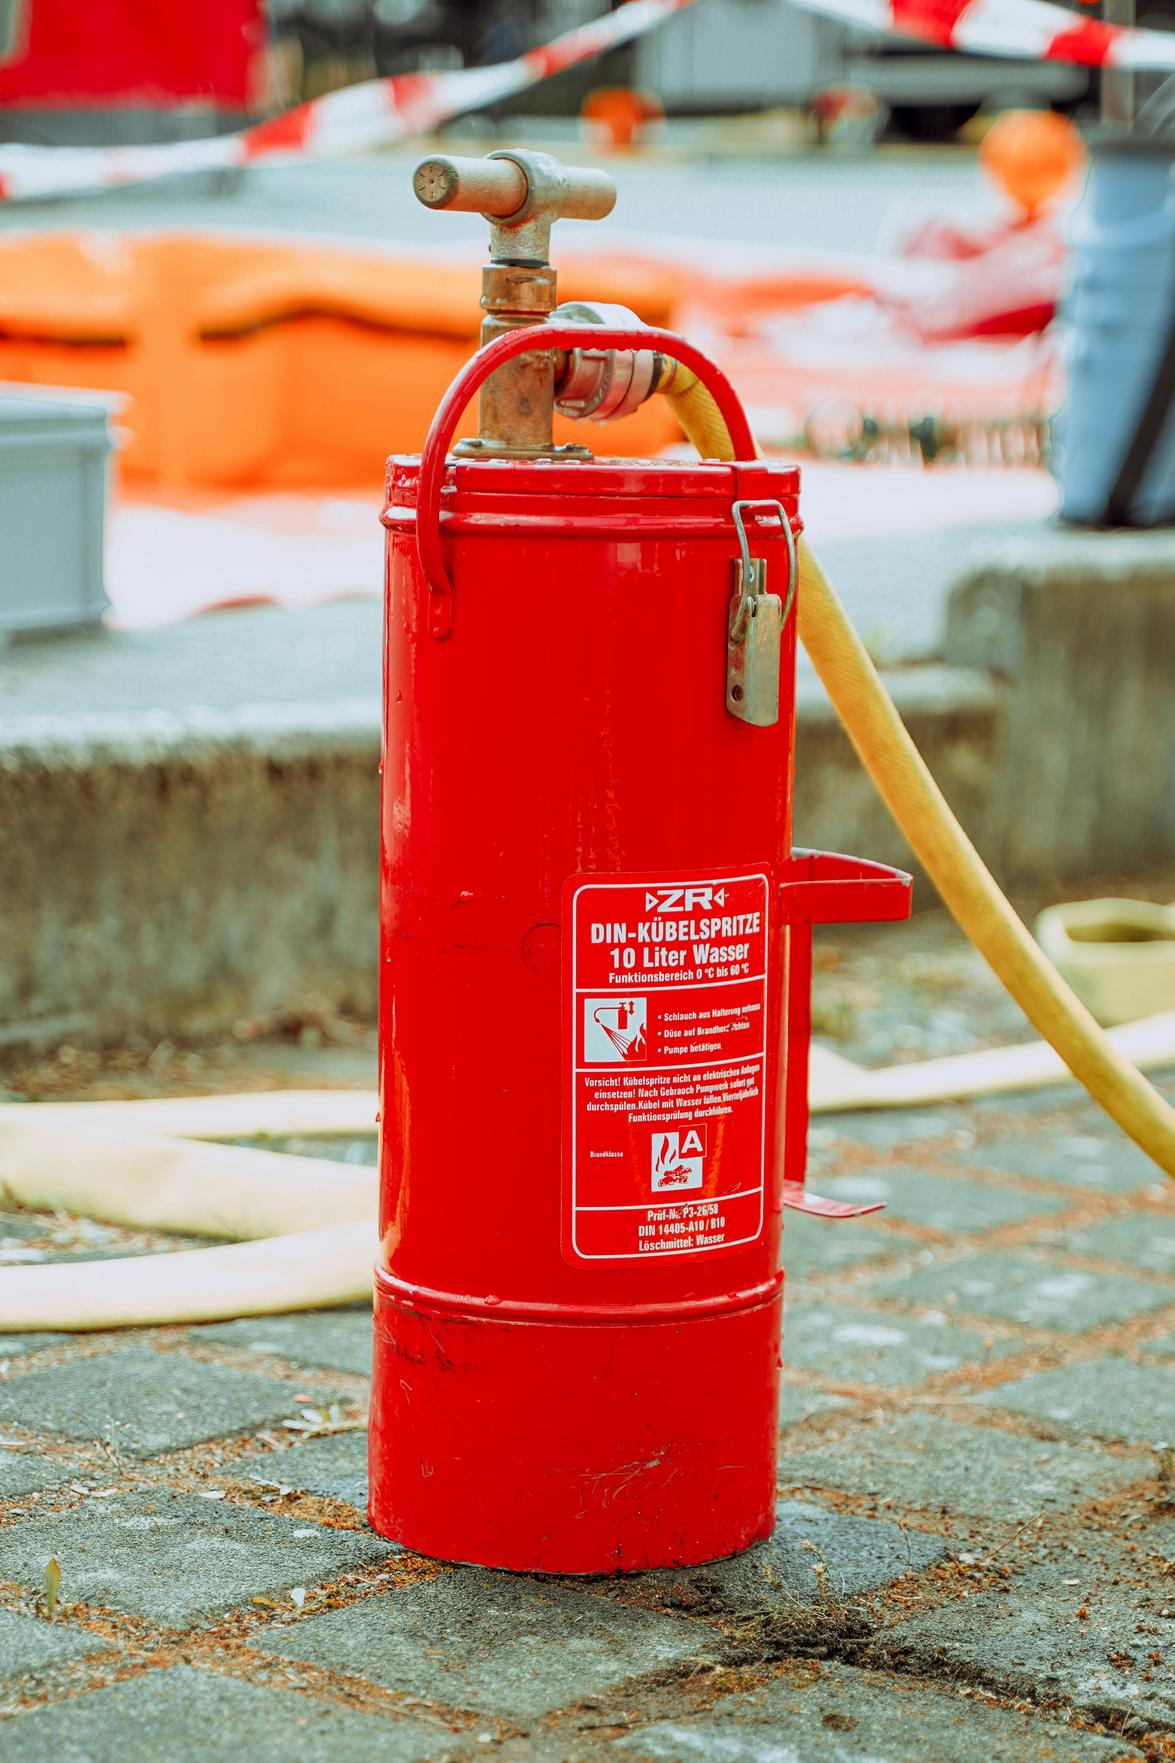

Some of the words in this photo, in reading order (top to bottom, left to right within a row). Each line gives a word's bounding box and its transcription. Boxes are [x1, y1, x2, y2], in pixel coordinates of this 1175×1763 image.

[657, 887, 713, 913] ZR
[591, 911, 760, 944] DIN-KÜBELSPRITZE
[610, 947, 636, 969] 10
[643, 947, 687, 968] Liter
[692, 942, 750, 965] Wasser
[609, 971, 694, 984] Funktionsbereich
[696, 968, 702, 979] 0
[716, 966, 728, 978] bis
[730, 964, 740, 976] 60
[664, 1011, 697, 1021] Schlauch
[712, 1007, 741, 1018] Halterung
[664, 1029, 682, 1038] Düse
[684, 1027, 696, 1037] auf
[664, 1046, 688, 1055] Pumpe
[584, 1077, 620, 1087] Vorsicht!
[623, 1075, 671, 1087] Kübelspritze
[672, 1074, 691, 1084] nicht
[692, 1074, 702, 1082] an
[702, 1068, 740, 1081] elektrischen
[594, 1090, 636, 1099] einsetzen!
[638, 1088, 658, 1098] Nach
[660, 1084, 694, 1097] Gebrauch
[696, 1081, 729, 1094] Pumpwerk
[661, 1099, 674, 1108] mit
[676, 1097, 702, 1108] Wasser
[628, 1110, 692, 1122] Funktionsprüfung
[681, 1130, 704, 1154] A
[638, 1225, 656, 1237] DIN
[658, 1220, 704, 1235] 14405-A10
[710, 1216, 726, 1230] B10
[639, 1236, 694, 1252] Löschmittel:
[696, 1234, 726, 1246] Wasser
